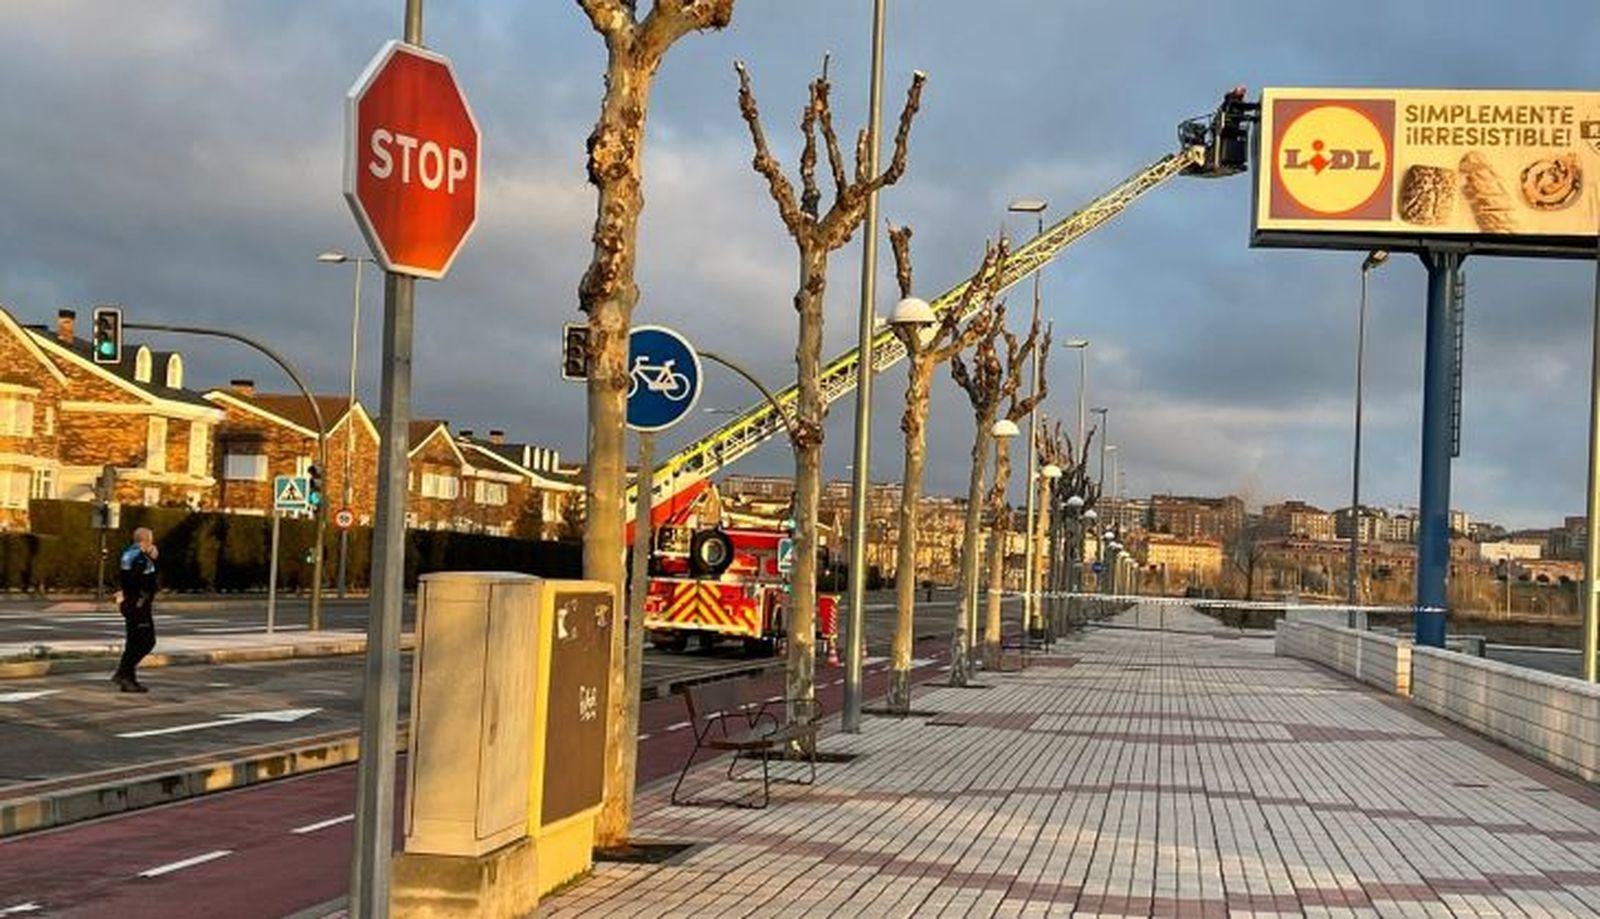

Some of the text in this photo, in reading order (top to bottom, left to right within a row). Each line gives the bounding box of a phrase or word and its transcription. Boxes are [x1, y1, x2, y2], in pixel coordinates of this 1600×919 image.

[1405, 104, 1574, 125] SIMPLEMENTE
[1406, 126, 1572, 147] ¡IRRESISTIBLE!
[369, 128, 468, 194] STOP
